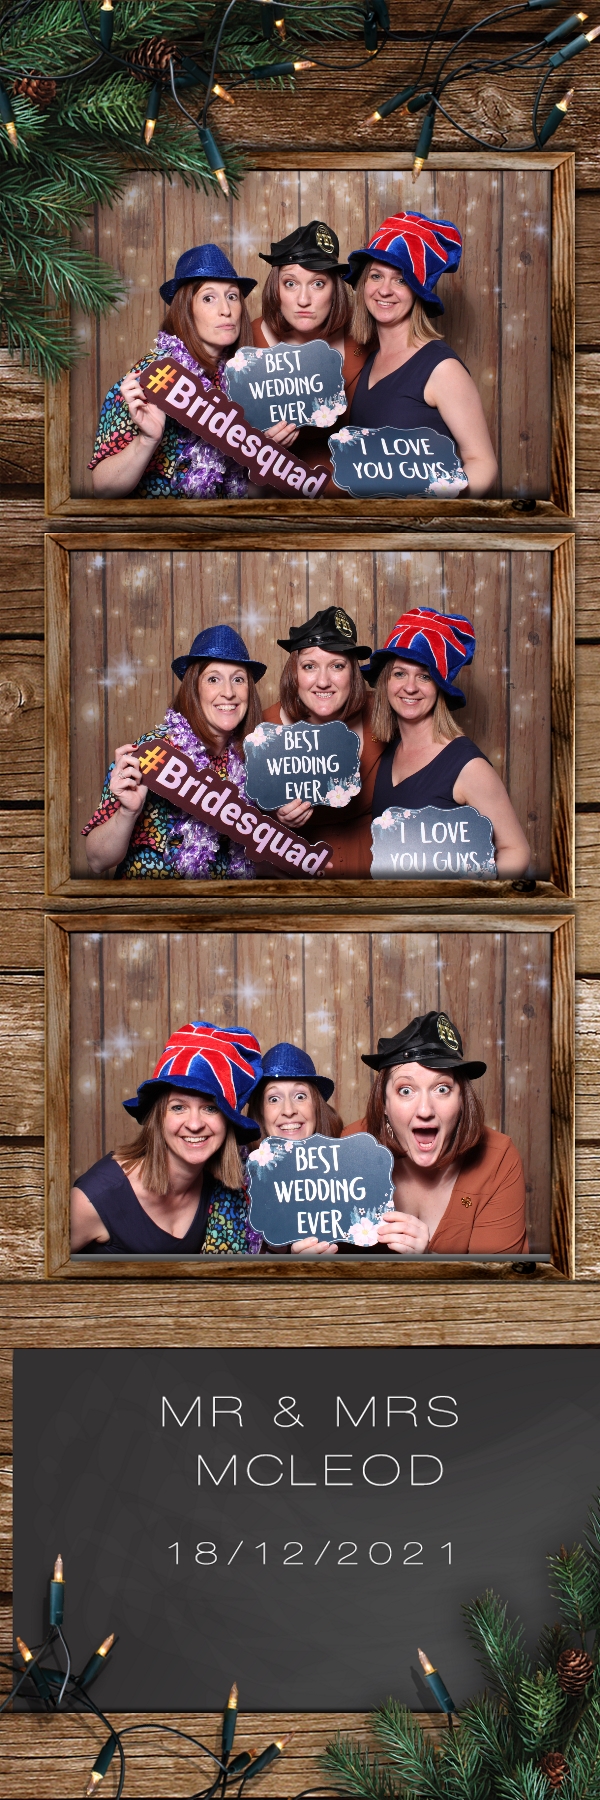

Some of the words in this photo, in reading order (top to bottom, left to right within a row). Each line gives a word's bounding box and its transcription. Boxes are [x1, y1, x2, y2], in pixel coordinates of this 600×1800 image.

[265, 350, 301, 373] BEST
[249, 374, 324, 400] WEDDING
[269, 401, 309, 423] EVER
[146, 364, 328, 499] #Bridesquad
[360, 438, 367, 455] I
[381, 438, 434, 456] LOVE
[353, 462, 393, 479] YOU
[399, 462, 450, 480] GUYS
[285, 729, 320, 751] BEST
[267, 754, 339, 775] WEDDING
[286, 780, 325, 801] EVER
[139, 745, 329, 875] #Bridesquad
[400, 822, 406, 843] I
[420, 821, 470, 843] LOVE
[390, 852, 427, 873] YOU
[433, 851, 481, 873] GUYS
[295, 1145, 340, 1173] BEST
[274, 1177, 366, 1203] WEDDING
[297, 1209, 346, 1238] EVER
